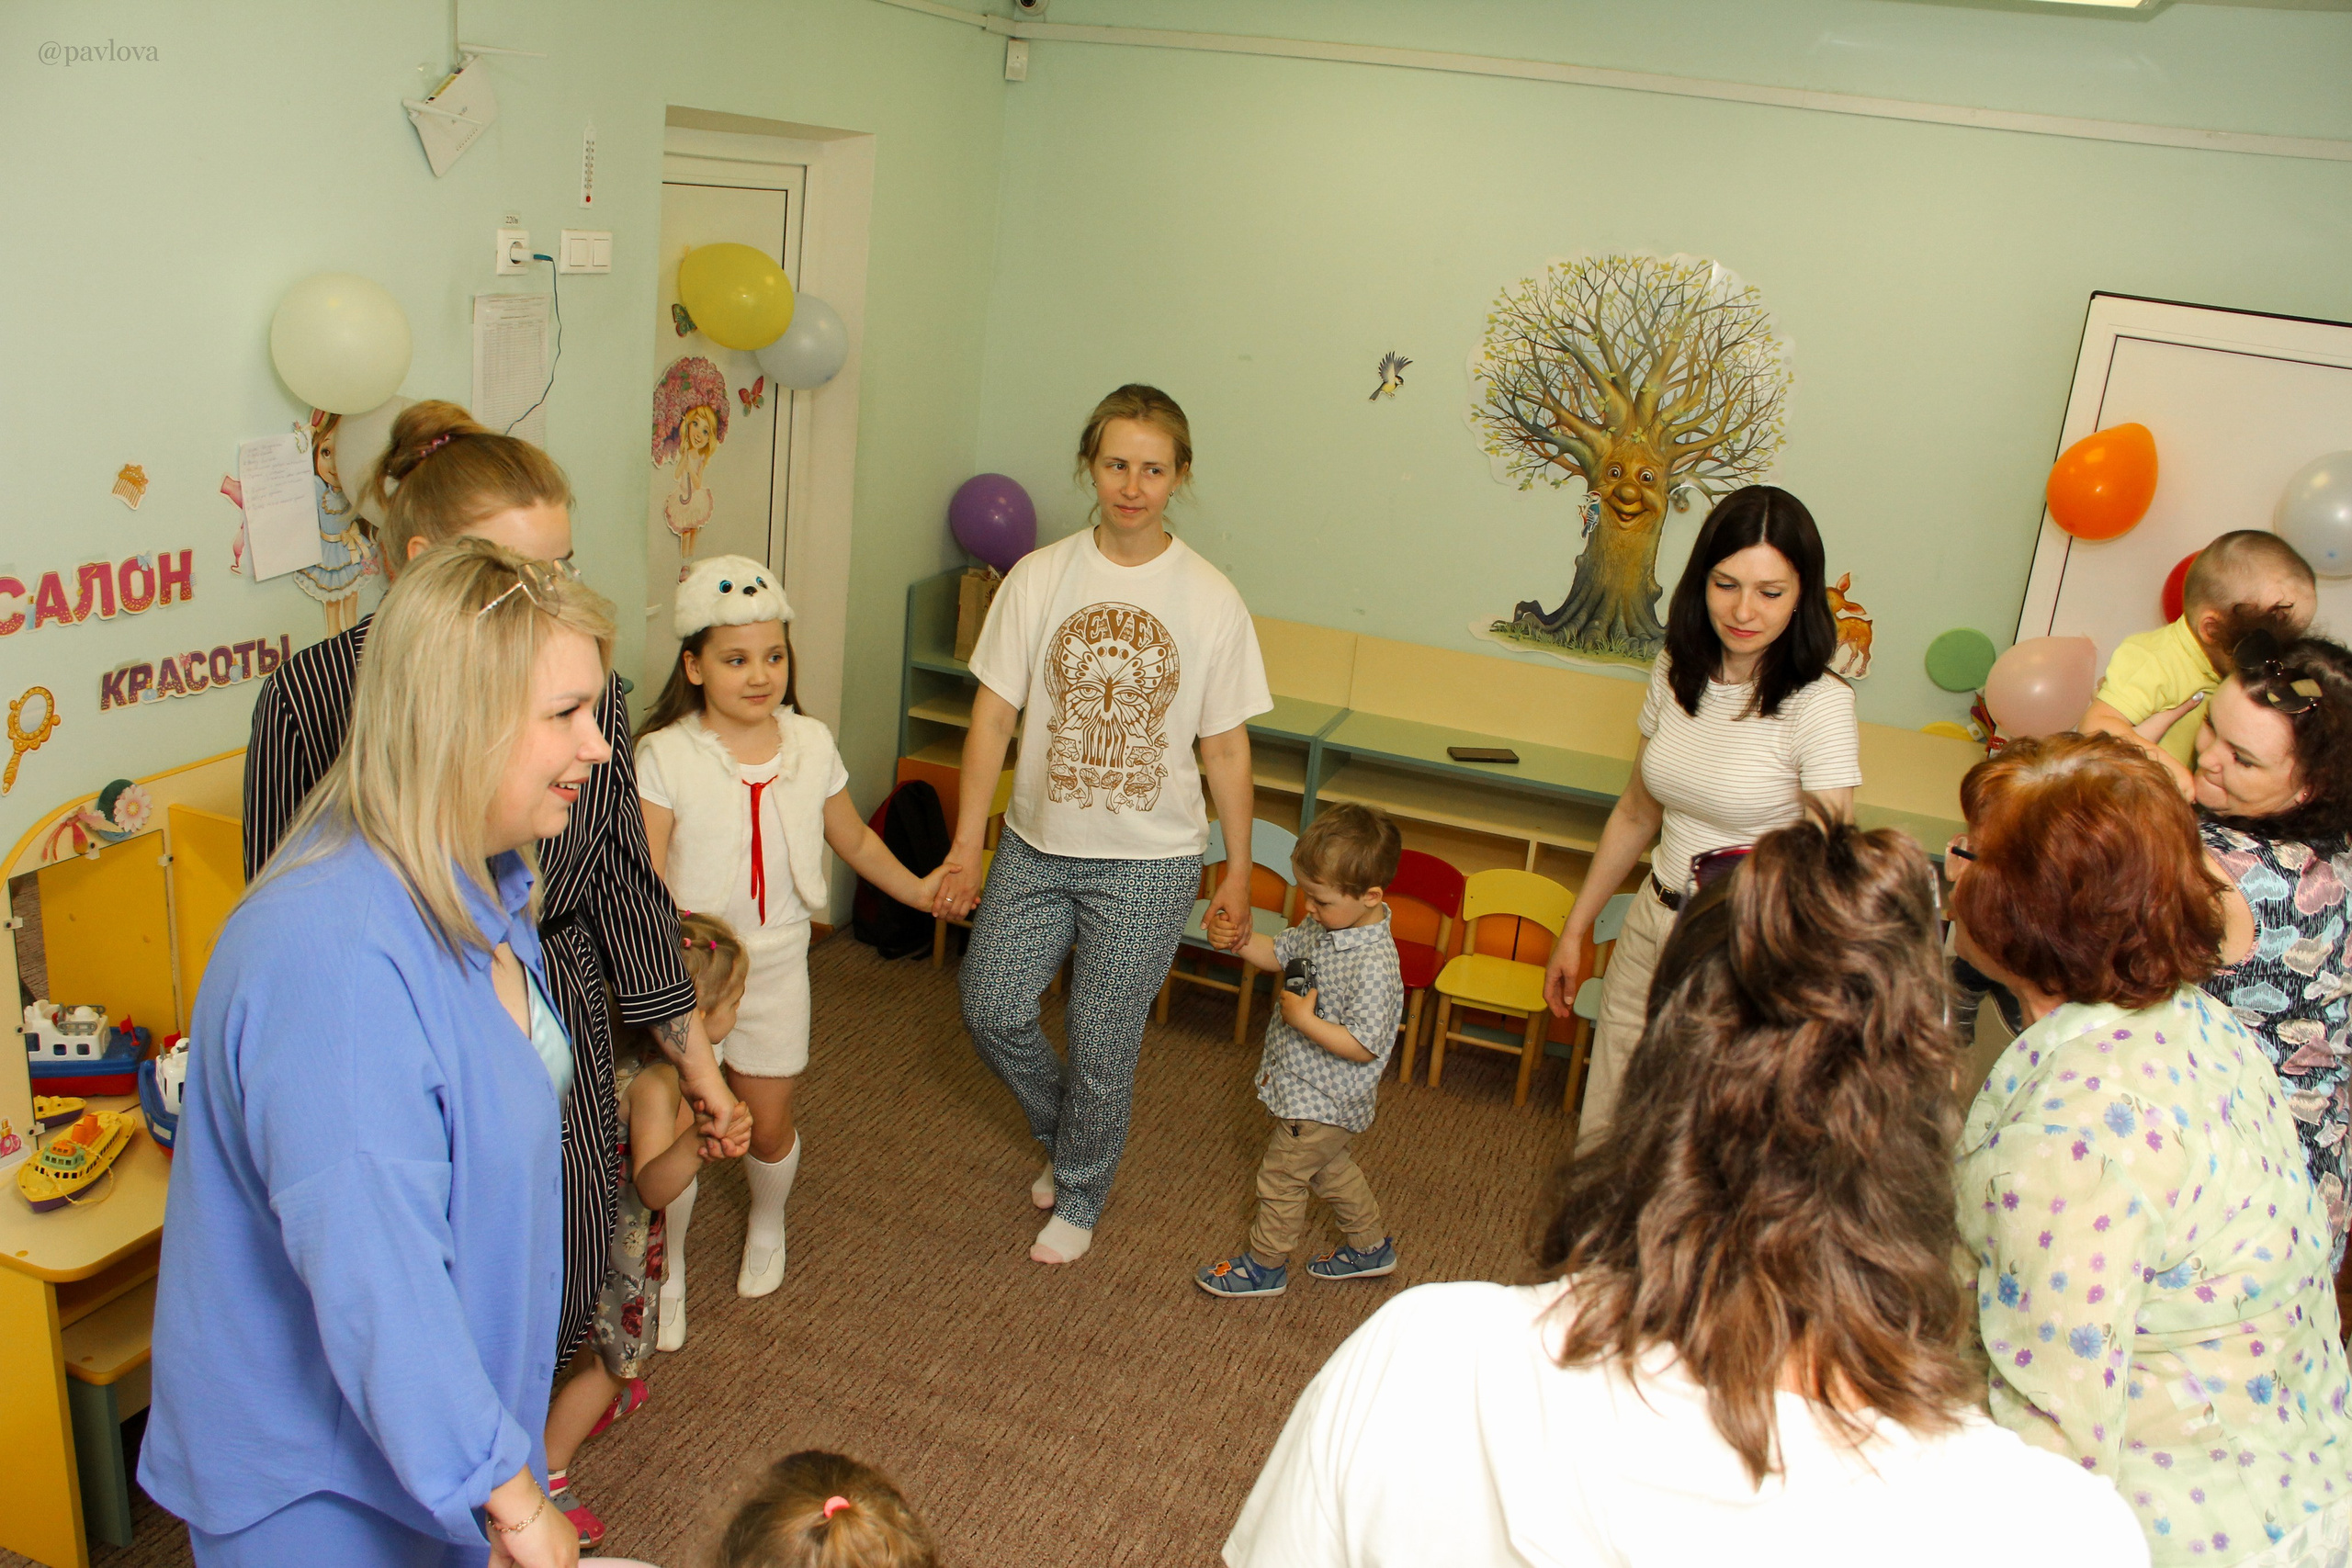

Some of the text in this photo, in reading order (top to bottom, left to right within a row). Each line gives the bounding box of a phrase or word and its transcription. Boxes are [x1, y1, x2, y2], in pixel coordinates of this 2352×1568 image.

[0, 548, 194, 637] САЛОН
[1068, 608, 1170, 652] LEVEL
[100, 634, 291, 711] КРАСОТЫ
